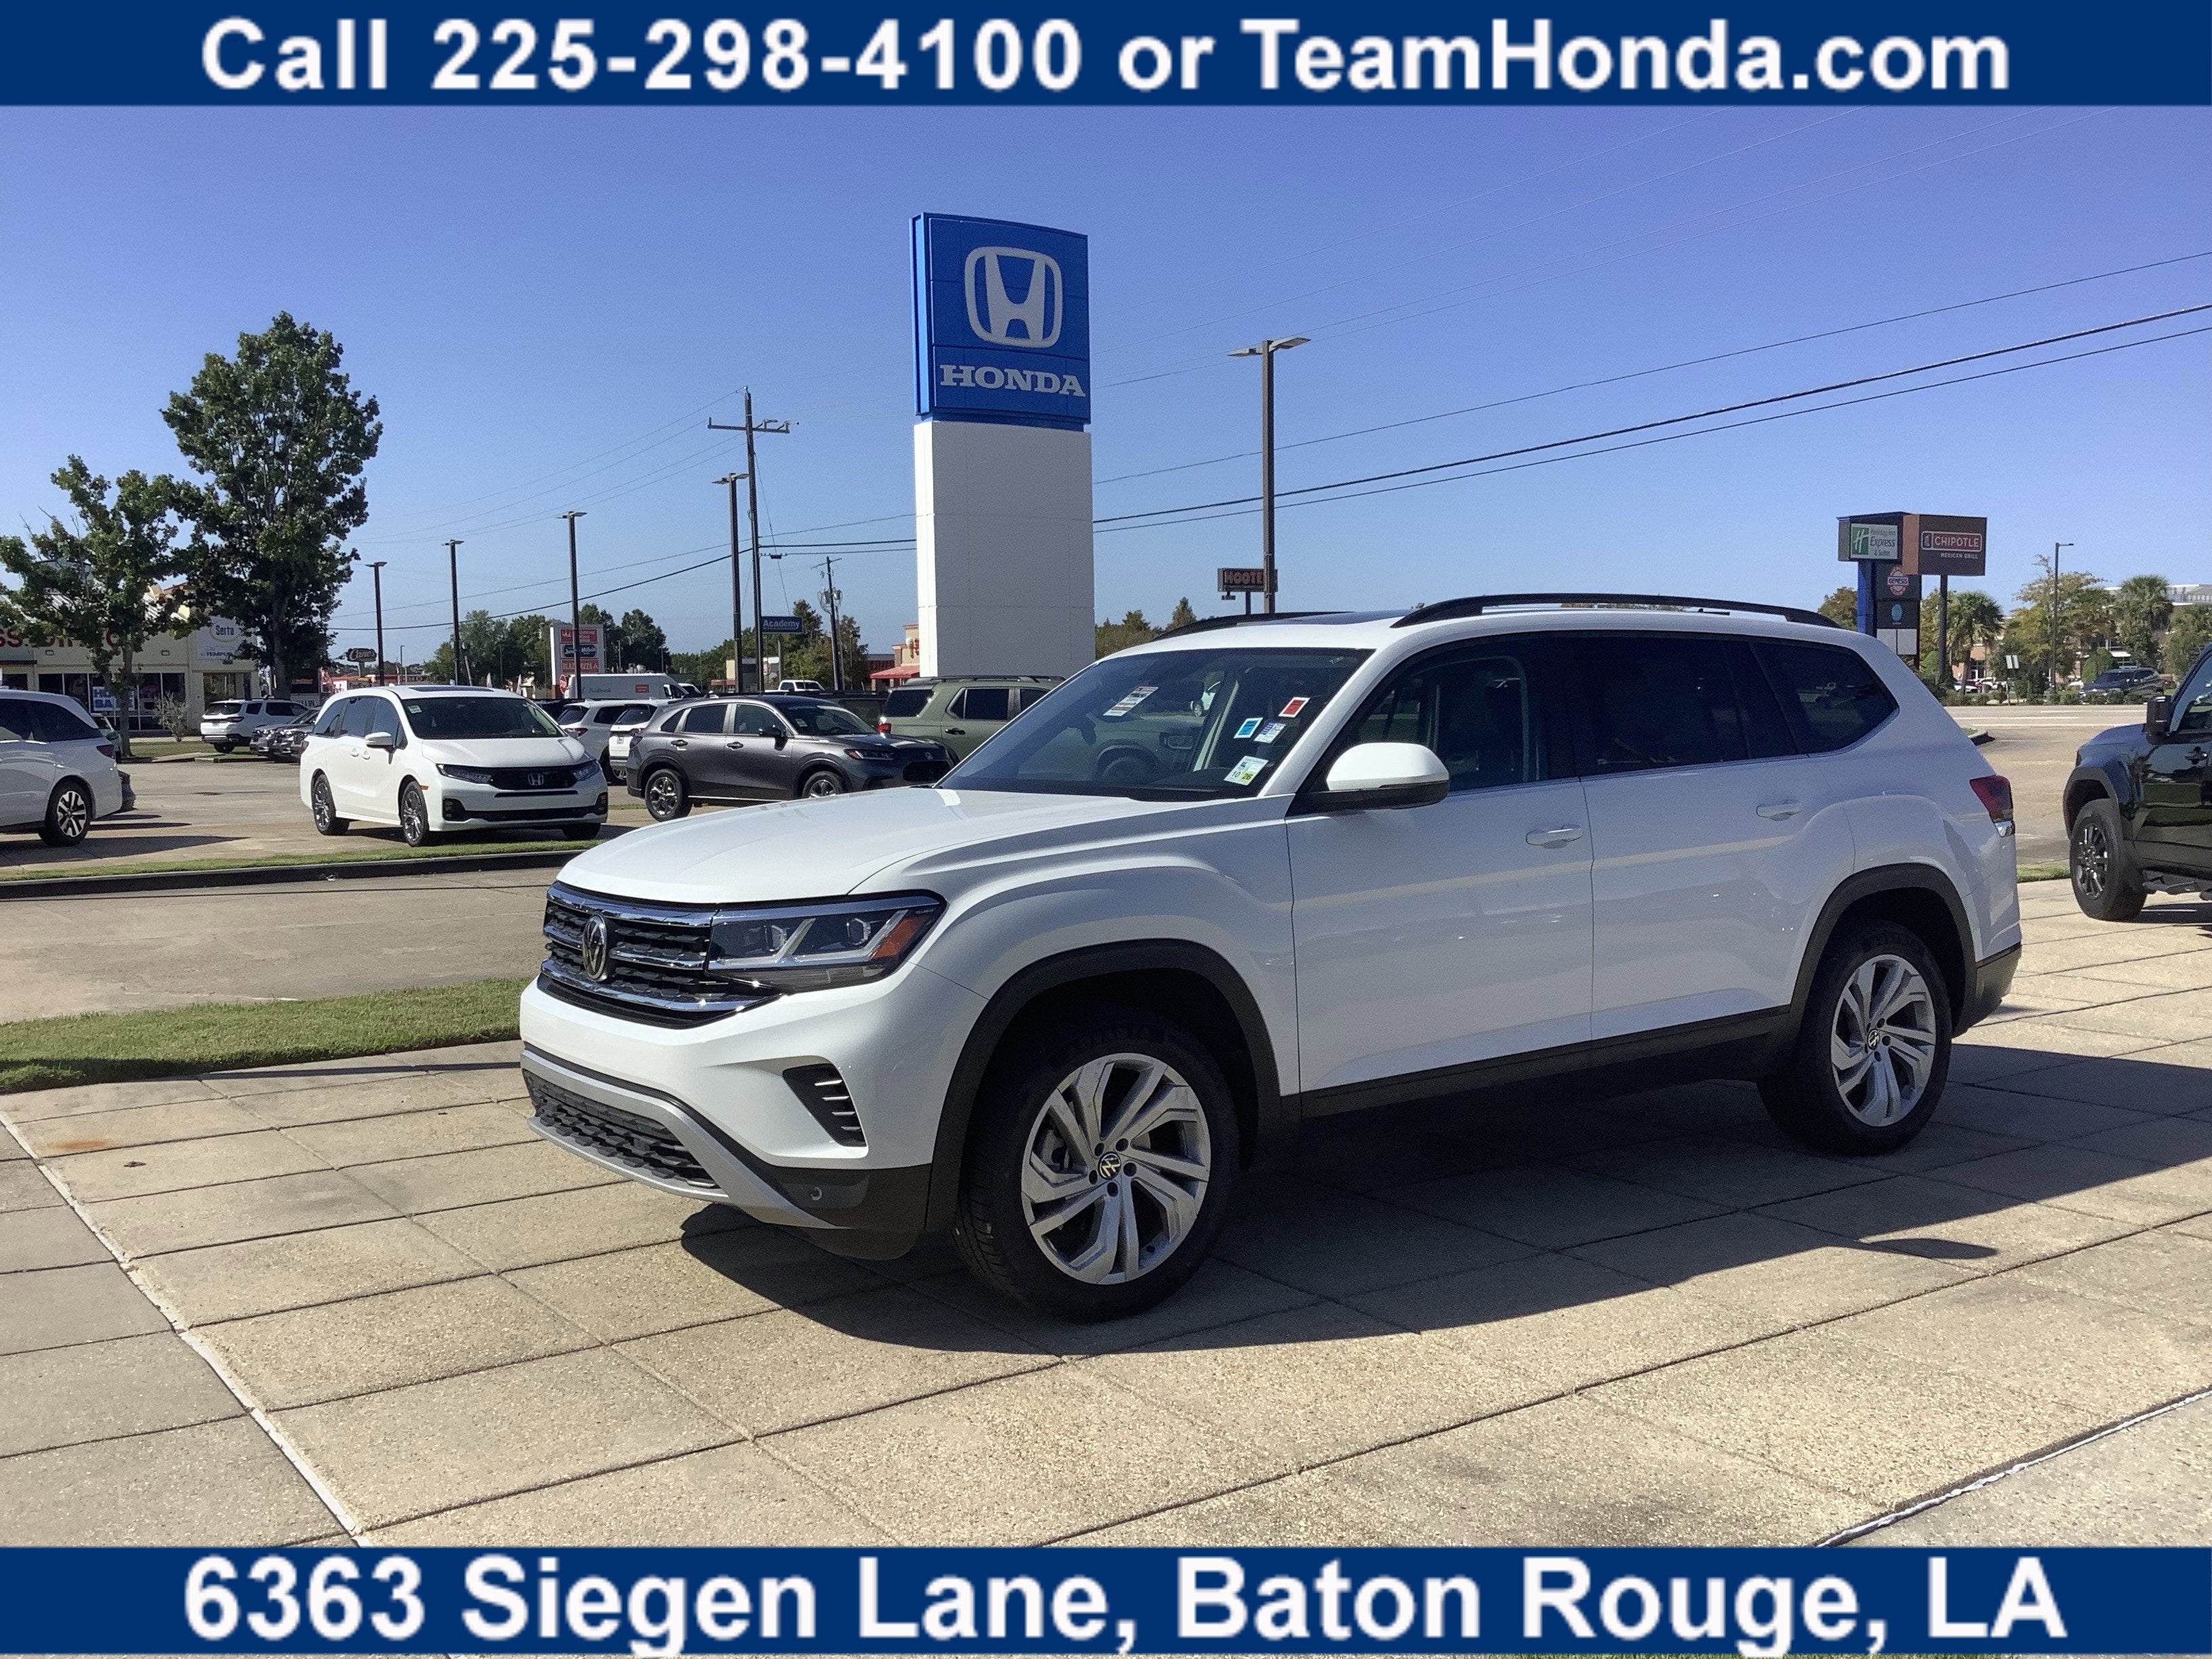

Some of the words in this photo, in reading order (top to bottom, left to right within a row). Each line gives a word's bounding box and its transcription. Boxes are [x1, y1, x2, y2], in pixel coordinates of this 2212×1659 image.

[940, 365, 1086, 397] HONDA
[1870, 537, 1896, 548] Express
[1934, 536, 1979, 548] CHIPOTLE
[763, 619, 800, 630] Academy
[216, 625, 234, 636] Serta
